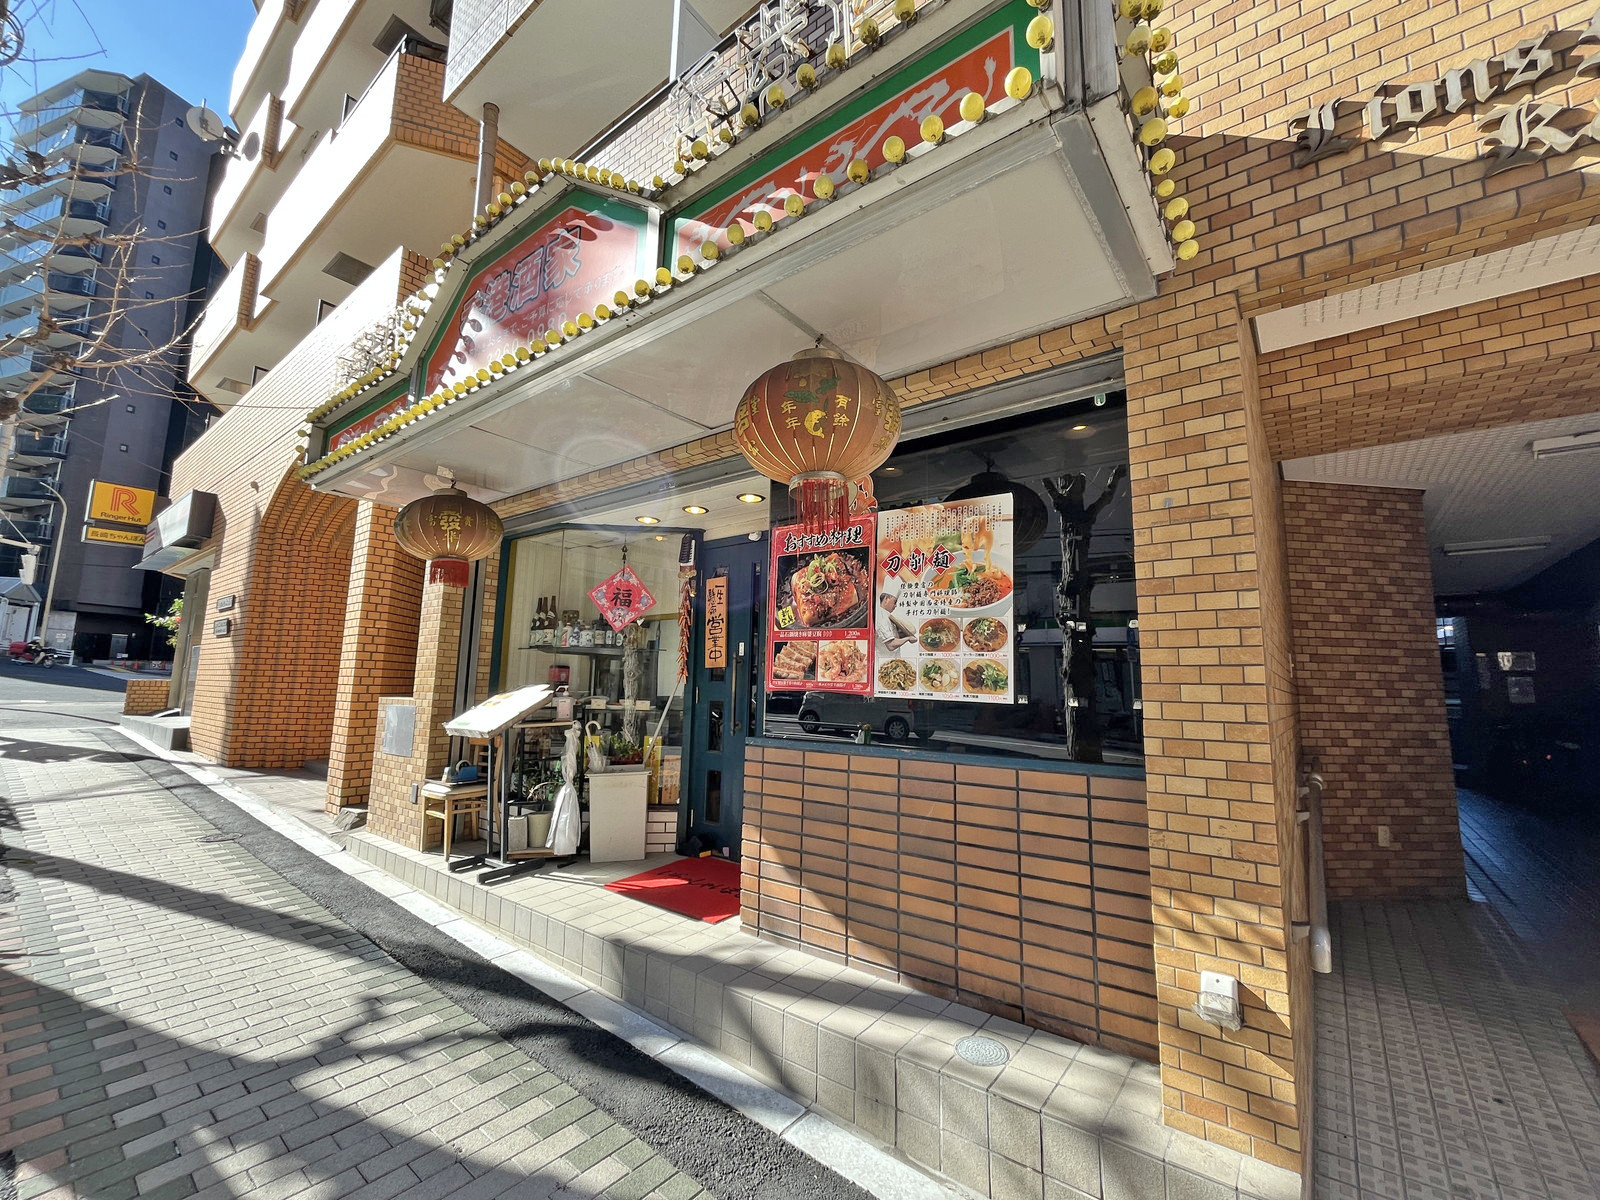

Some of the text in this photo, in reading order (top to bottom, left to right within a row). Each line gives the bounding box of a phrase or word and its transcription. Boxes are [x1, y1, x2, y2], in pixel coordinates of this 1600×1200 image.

[780, 400, 801, 431] 年年
[100, 511, 142, 523] Ringer Hut
[784, 525, 863, 553] おすすめ料理
[611, 587, 633, 608] 福
[706, 613, 725, 663] 営業中
